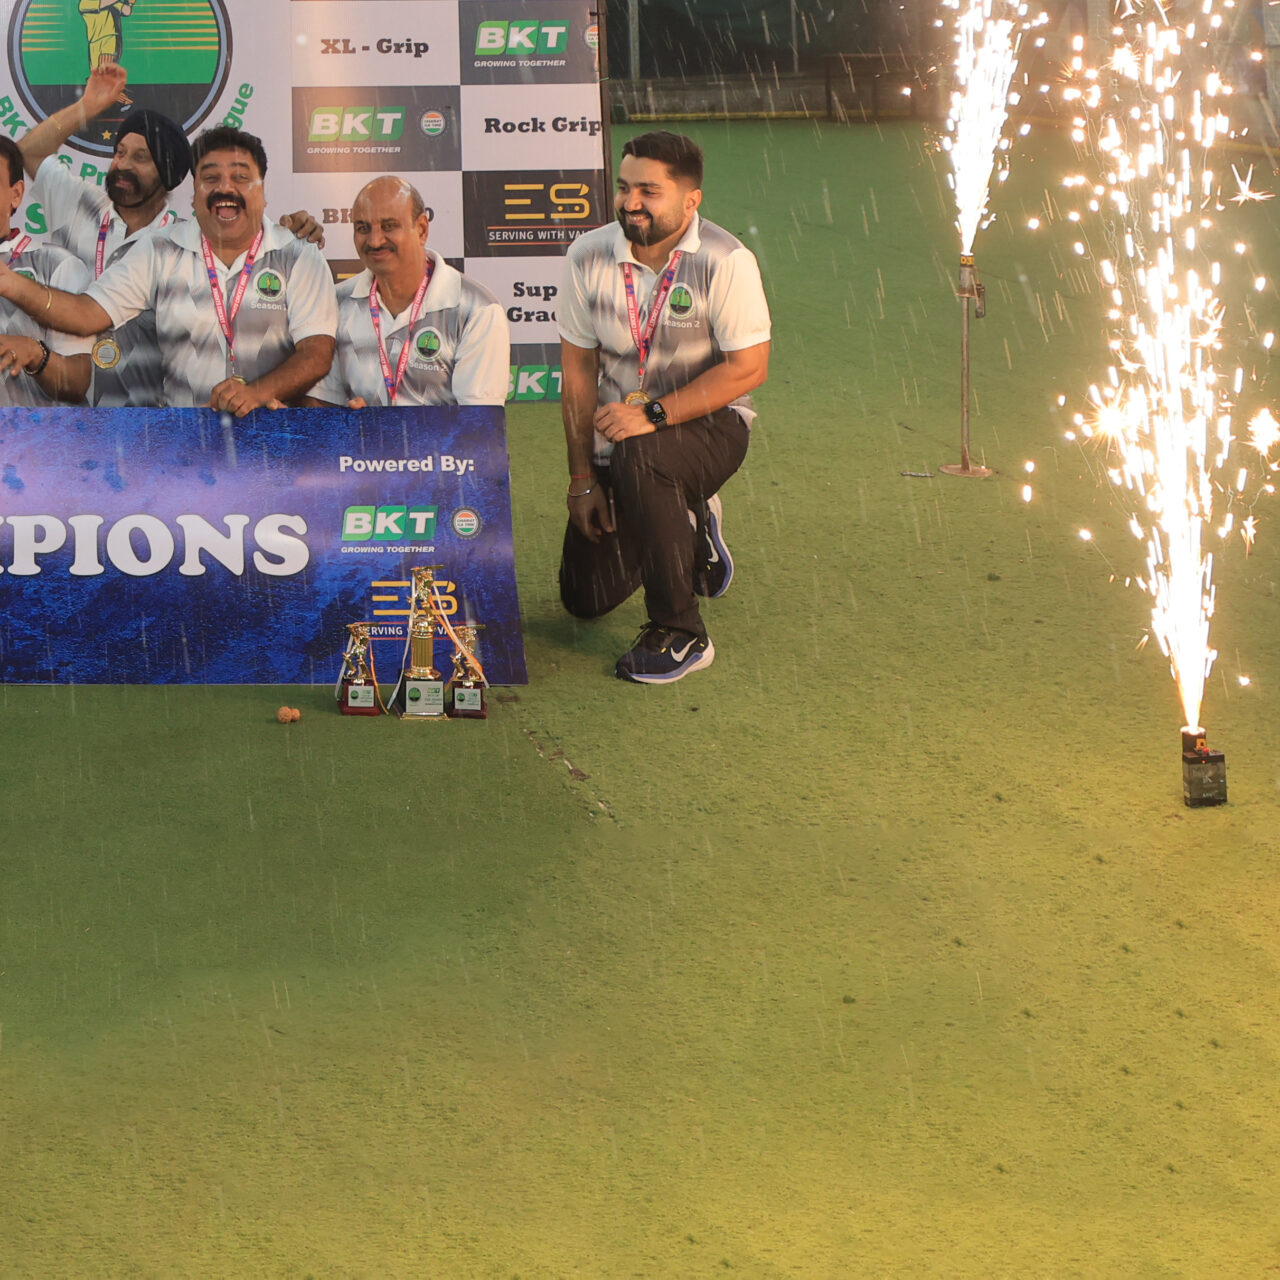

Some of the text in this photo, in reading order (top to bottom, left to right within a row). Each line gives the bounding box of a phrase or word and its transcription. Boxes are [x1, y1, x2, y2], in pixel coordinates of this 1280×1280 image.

[477, 26, 566, 49] BKT
[320, 39, 356, 54] XL
[376, 39, 429, 58] Grip
[474, 59, 566, 68] GROWING TOGETHER
[310, 112, 403, 135] BKT
[485, 117, 603, 136] Rock Grip
[504, 183, 590, 219] ES
[489, 231, 534, 240] SERVING
[538, 230, 565, 239] WITH
[513, 281, 558, 301] Sup
[507, 307, 557, 322] Gra
[339, 455, 475, 475] Powered By:
[345, 512, 434, 534] BKT
[363, 626, 403, 635] ERVING
